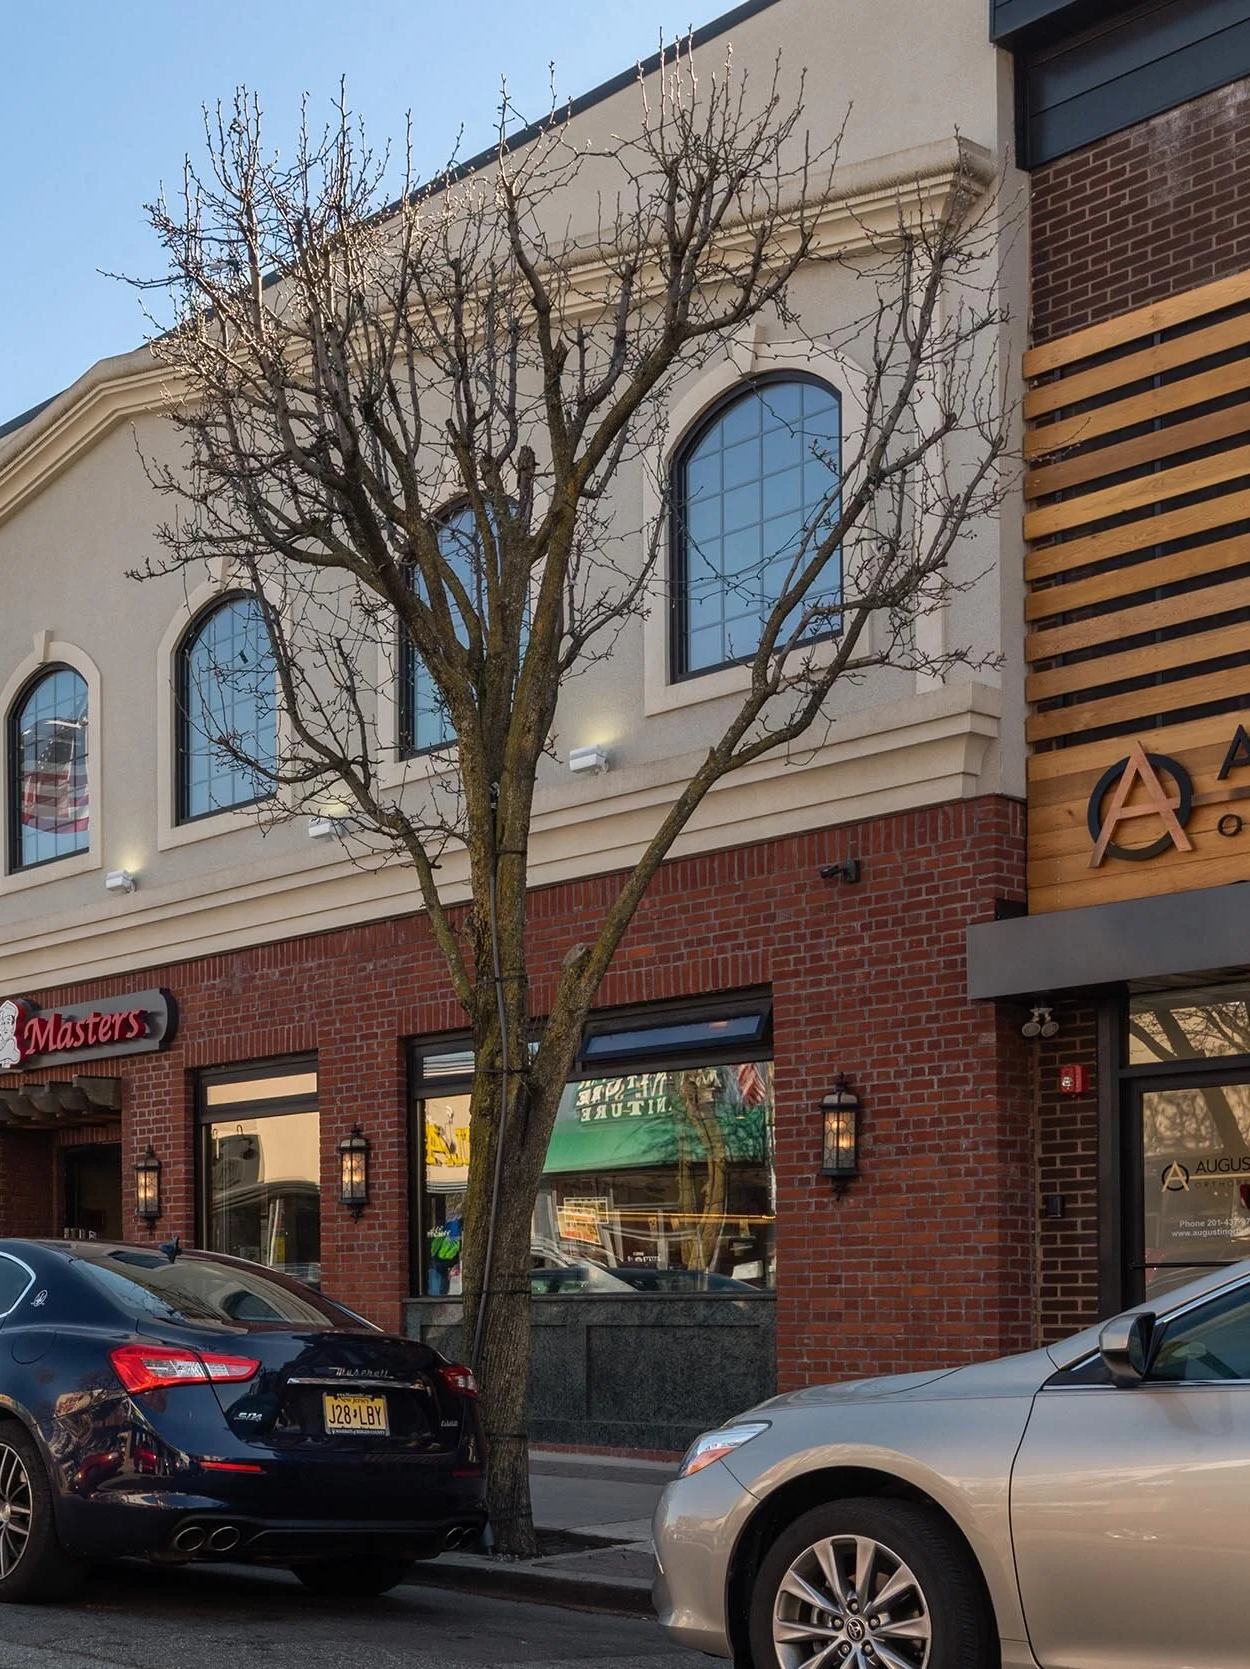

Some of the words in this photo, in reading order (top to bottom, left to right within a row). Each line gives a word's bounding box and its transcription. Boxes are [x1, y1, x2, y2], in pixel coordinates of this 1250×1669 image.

[24, 1009, 146, 1056] Masters
[1195, 1156, 1250, 1175] AUGUS
[1179, 1219, 1206, 1228] Phone
